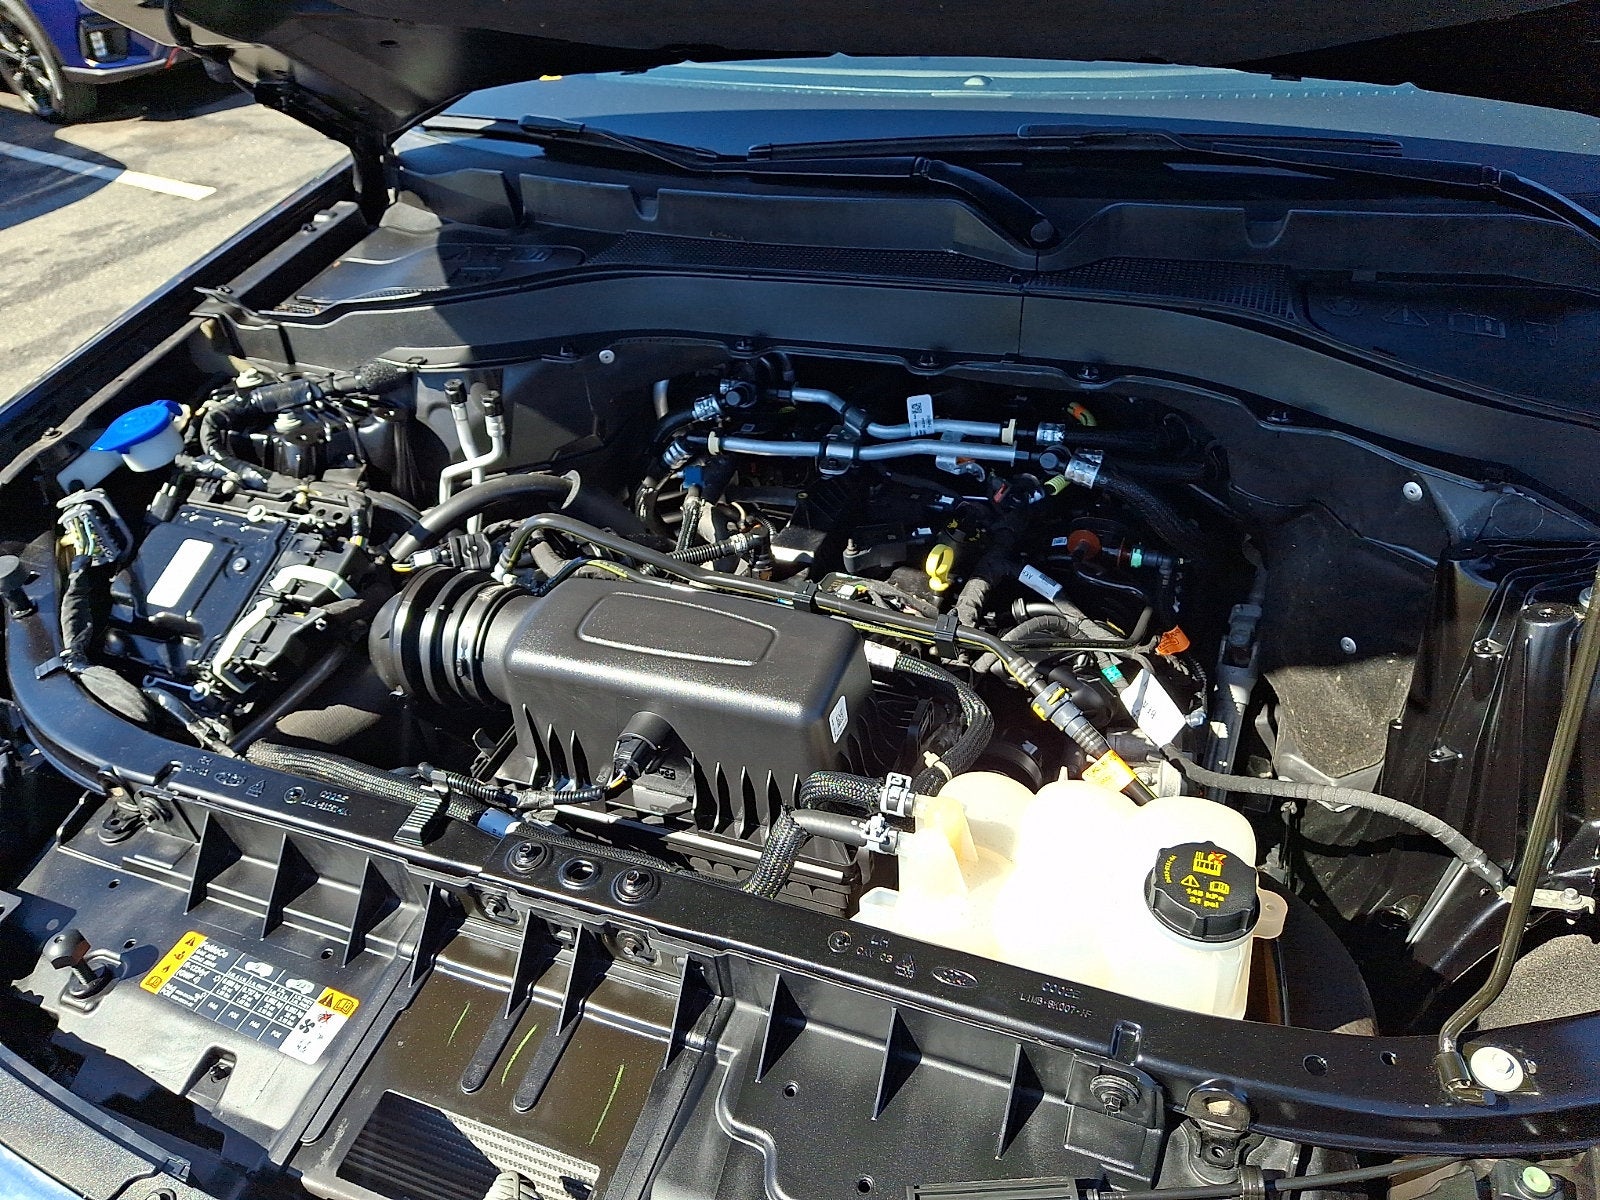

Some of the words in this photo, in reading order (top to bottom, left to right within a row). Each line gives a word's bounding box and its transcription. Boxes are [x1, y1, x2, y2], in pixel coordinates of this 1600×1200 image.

[1186, 888, 1204, 897] 145
[1205, 892, 1225, 902] kPa
[1189, 896, 1202, 904] 21
[1203, 900, 1219, 909] psi
